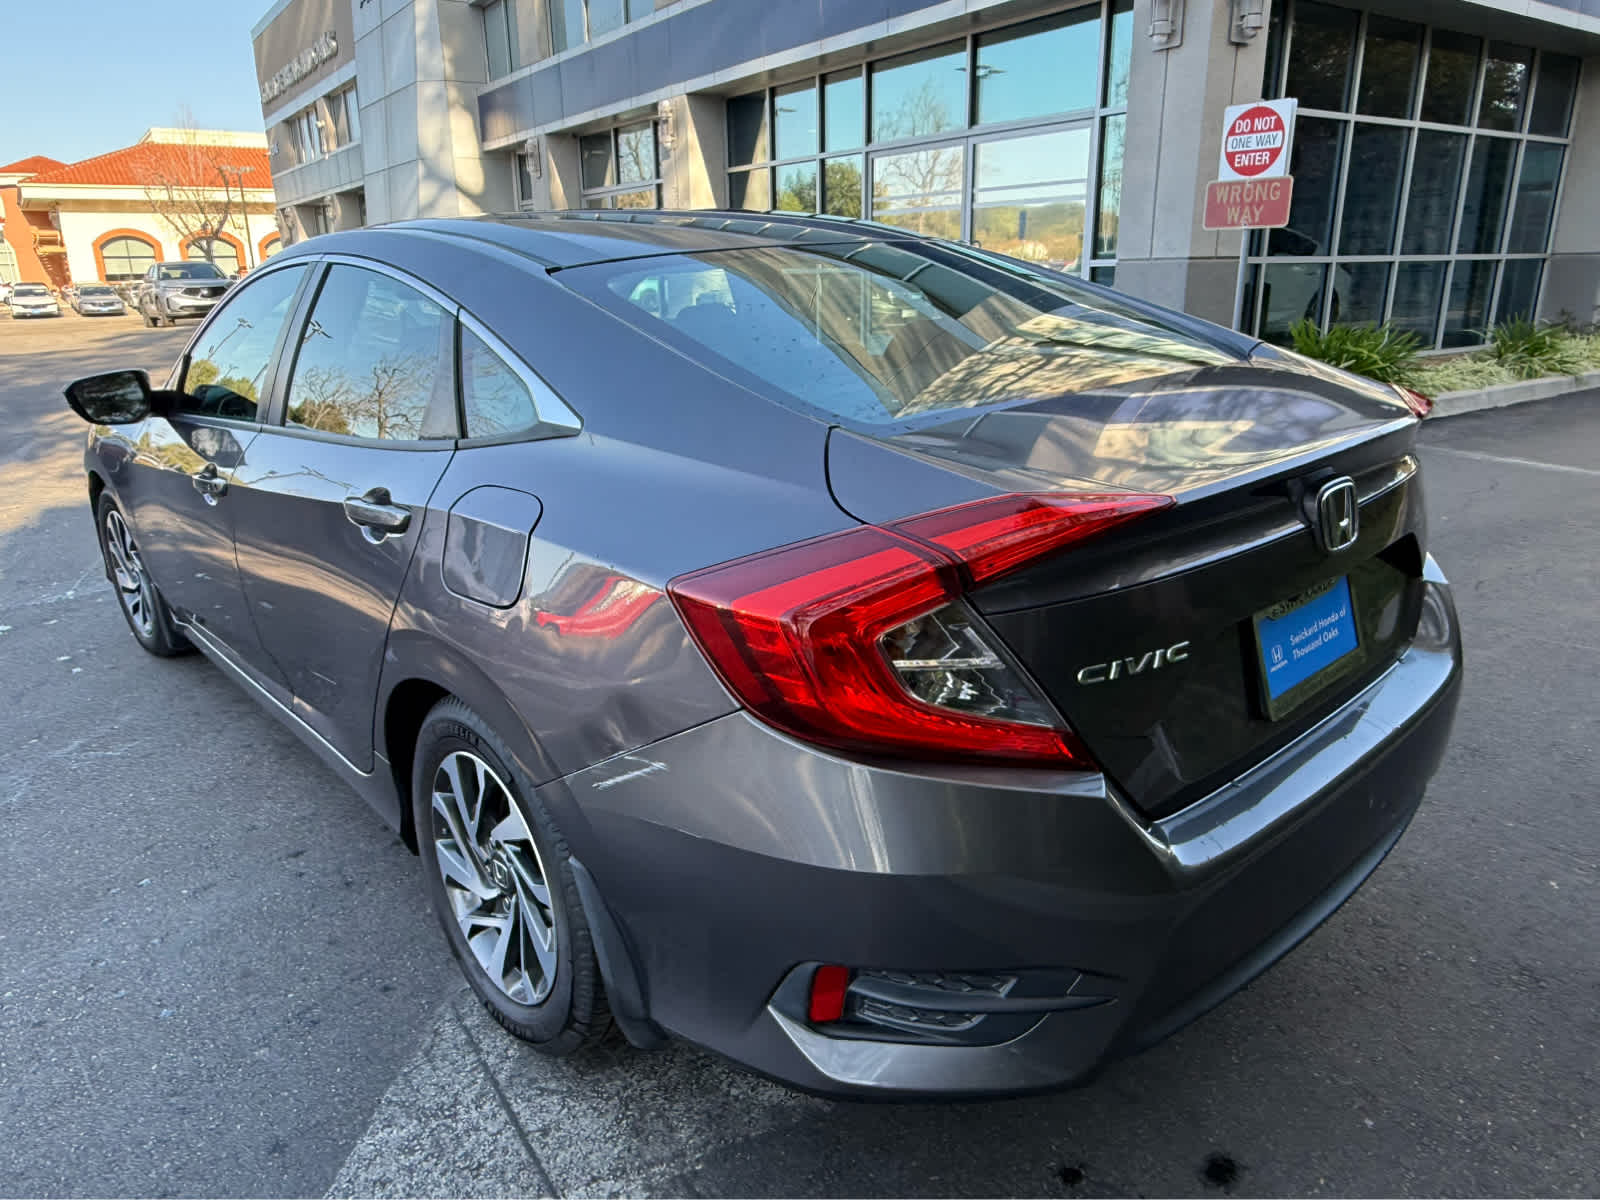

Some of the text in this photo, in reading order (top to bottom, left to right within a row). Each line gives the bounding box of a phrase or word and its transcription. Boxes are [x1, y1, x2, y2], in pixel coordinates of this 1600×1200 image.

[1235, 115, 1278, 133] DO NOT
[1231, 133, 1279, 149] ONE WAY
[1234, 151, 1270, 167] ENTER
[1216, 182, 1281, 203] WRONG
[1226, 205, 1264, 224] WAY
[1318, 613, 1340, 630] Honda
[1339, 606, 1347, 617] of
[1292, 627, 1339, 660] Thousand Oaks
[1077, 641, 1190, 684] CIVIC
